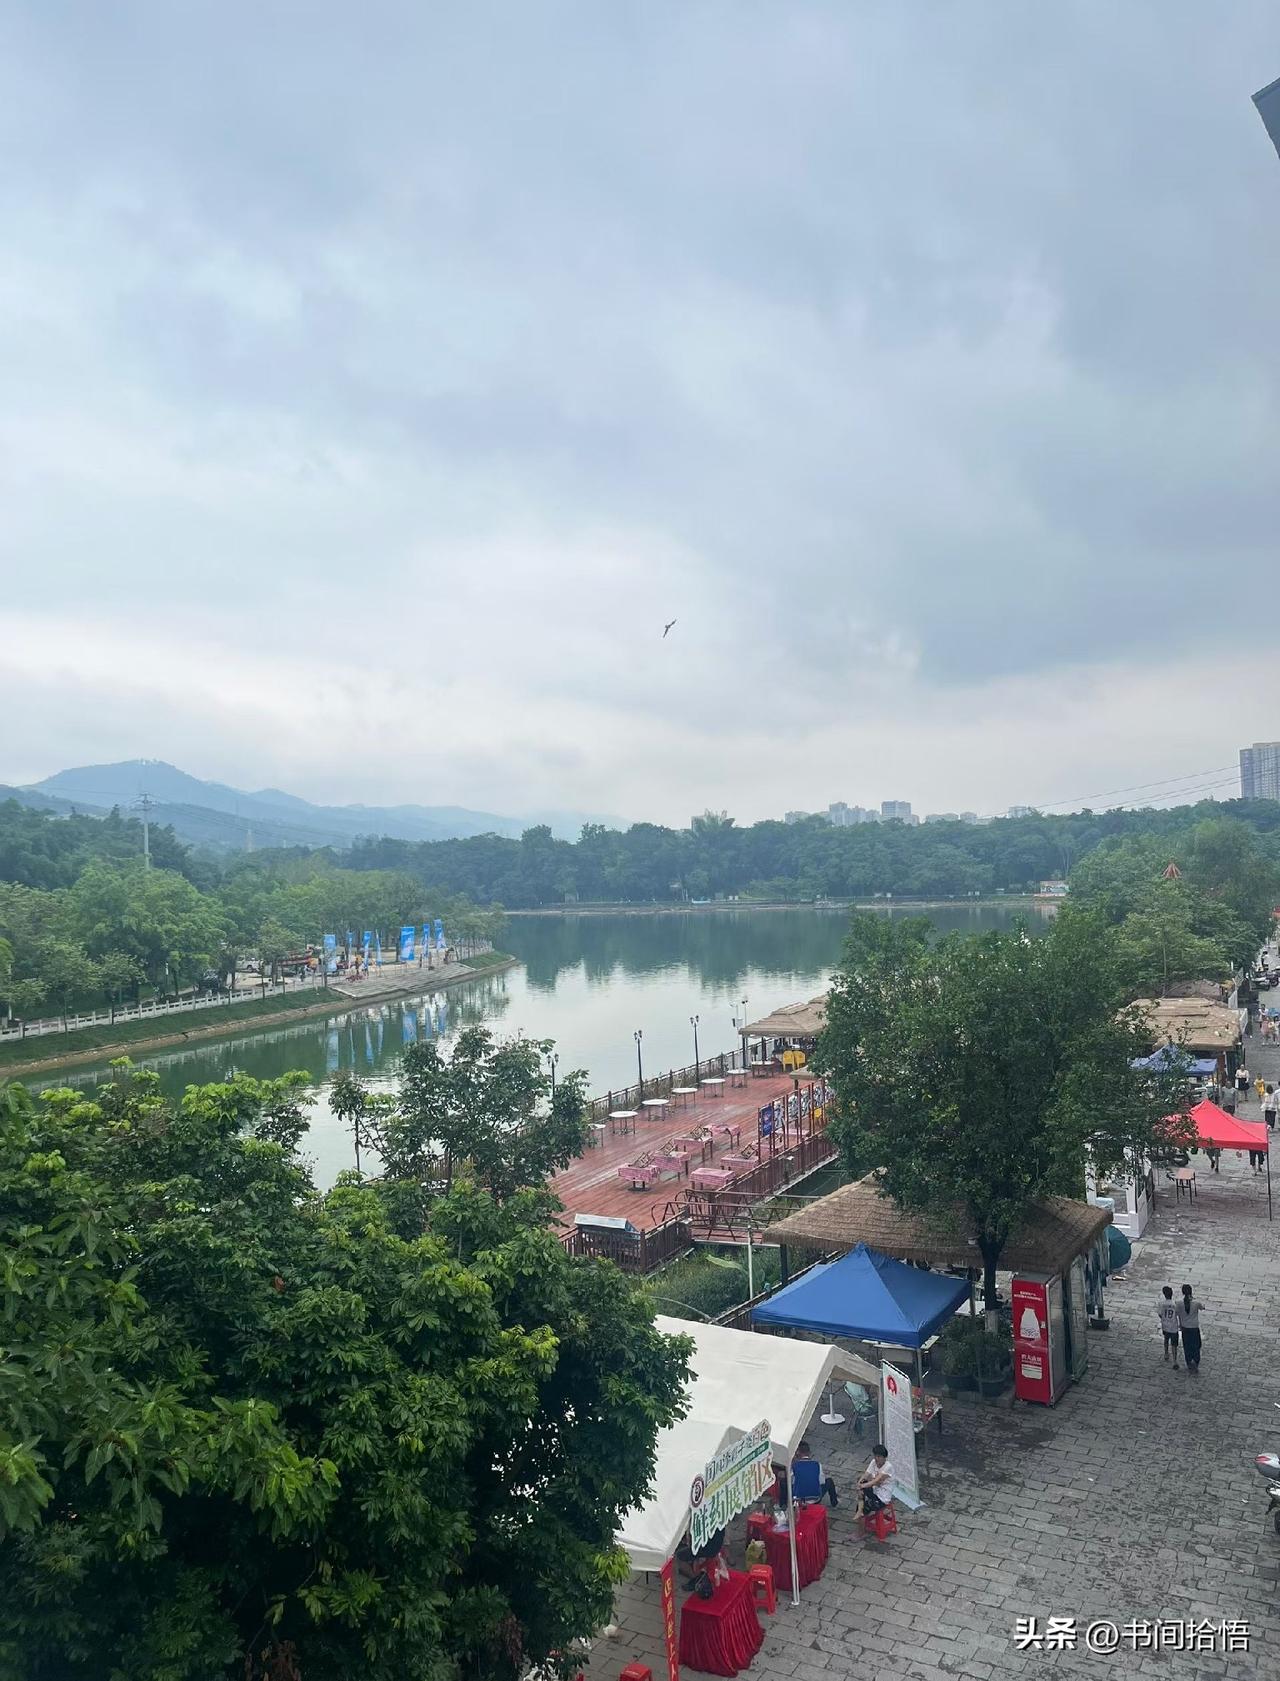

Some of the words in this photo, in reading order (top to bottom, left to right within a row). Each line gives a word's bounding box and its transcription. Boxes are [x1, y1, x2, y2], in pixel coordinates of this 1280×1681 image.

[692, 1451, 776, 1549] 鲜药展销区
